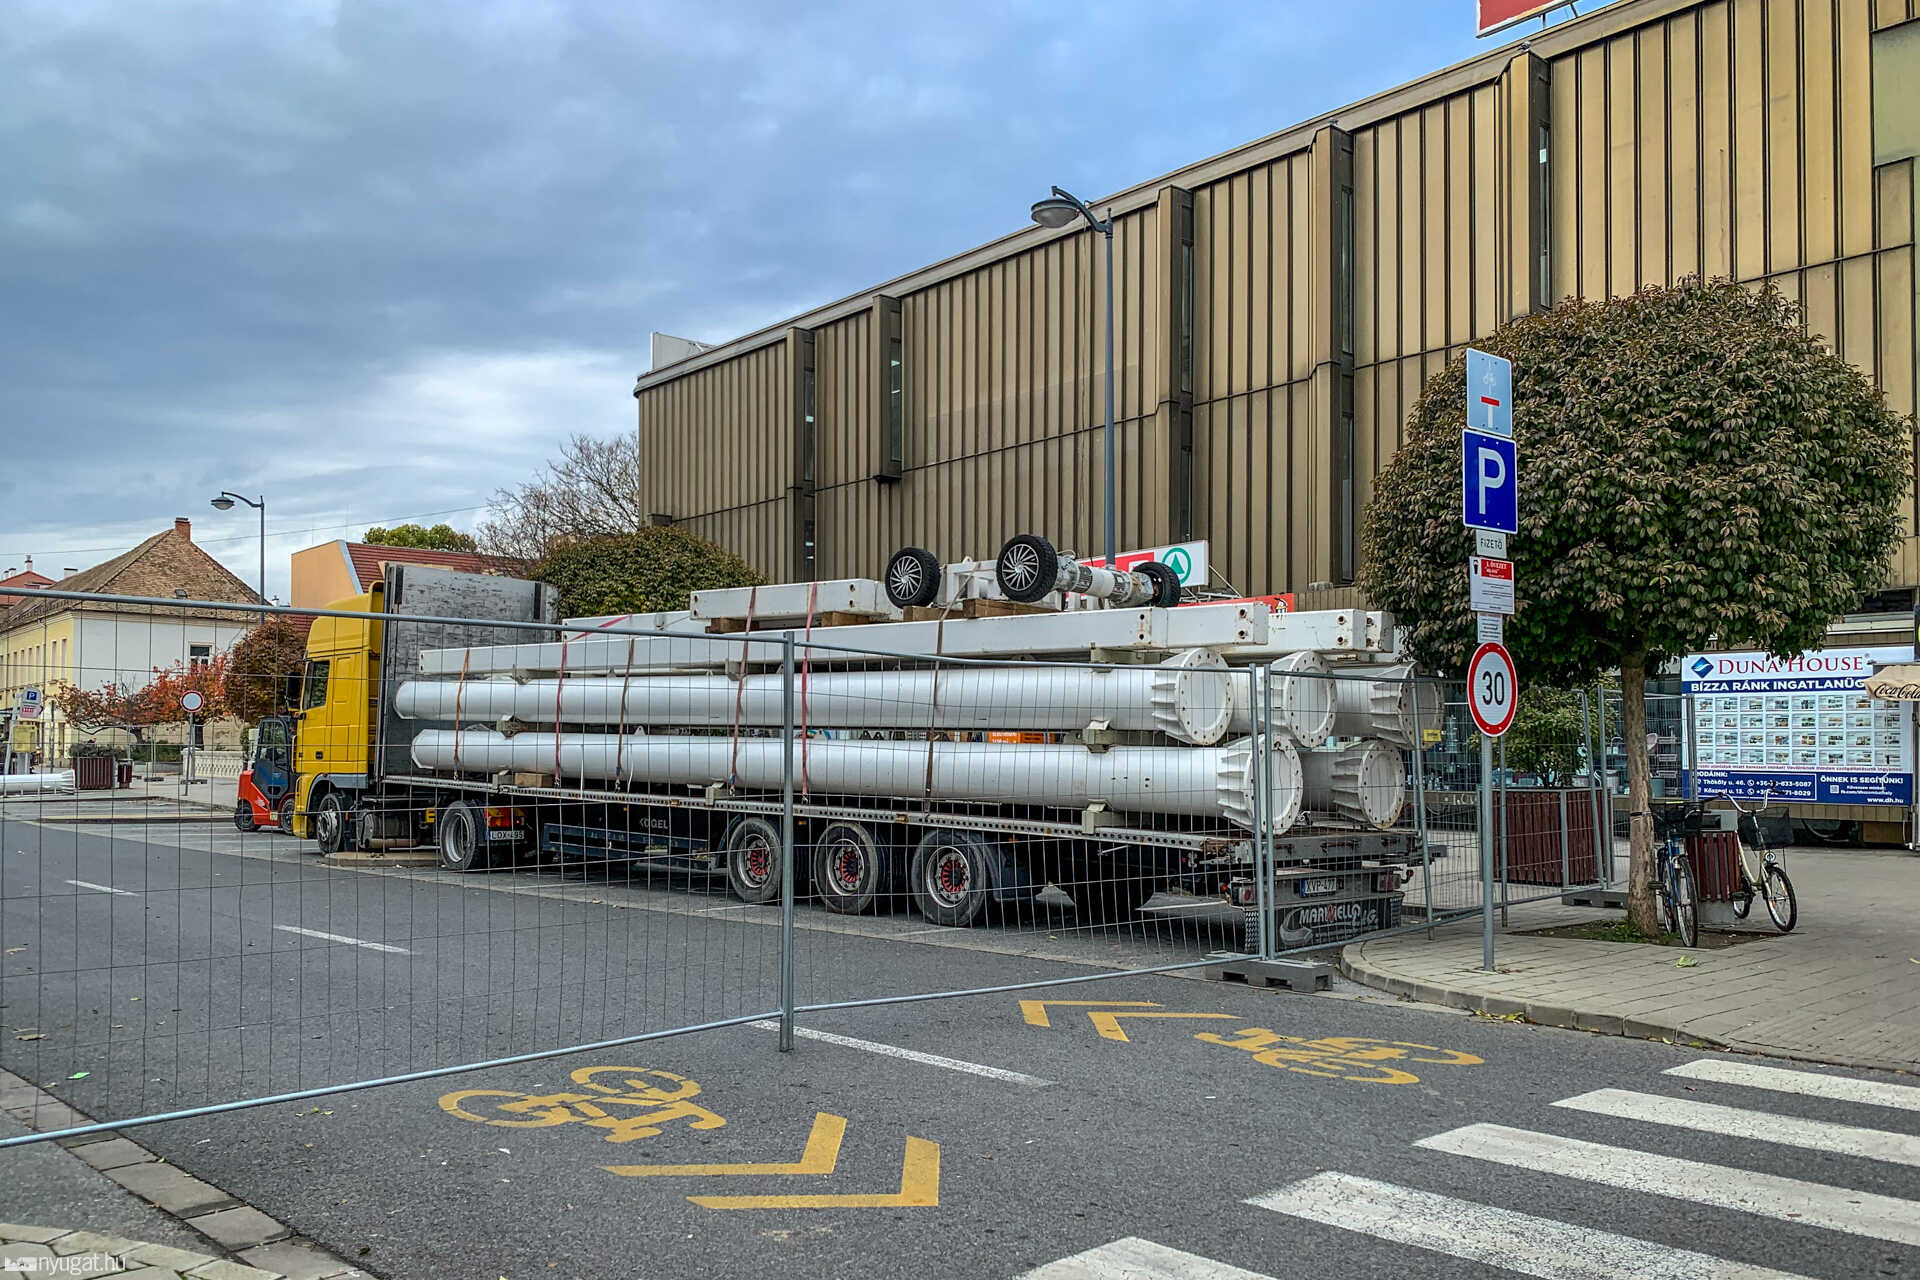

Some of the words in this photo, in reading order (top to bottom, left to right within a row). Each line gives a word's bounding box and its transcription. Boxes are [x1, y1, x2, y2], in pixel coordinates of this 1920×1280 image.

[1478, 446, 1506, 516] P
[1719, 659, 1780, 674] DUNA
[1787, 656, 1864, 672] HOUSE
[1482, 670, 1505, 706] 30
[1691, 681, 1730, 692] BÍZZA
[1733, 679, 1770, 691] RÁNK
[1820, 775, 1848, 783] ÖNNEK
